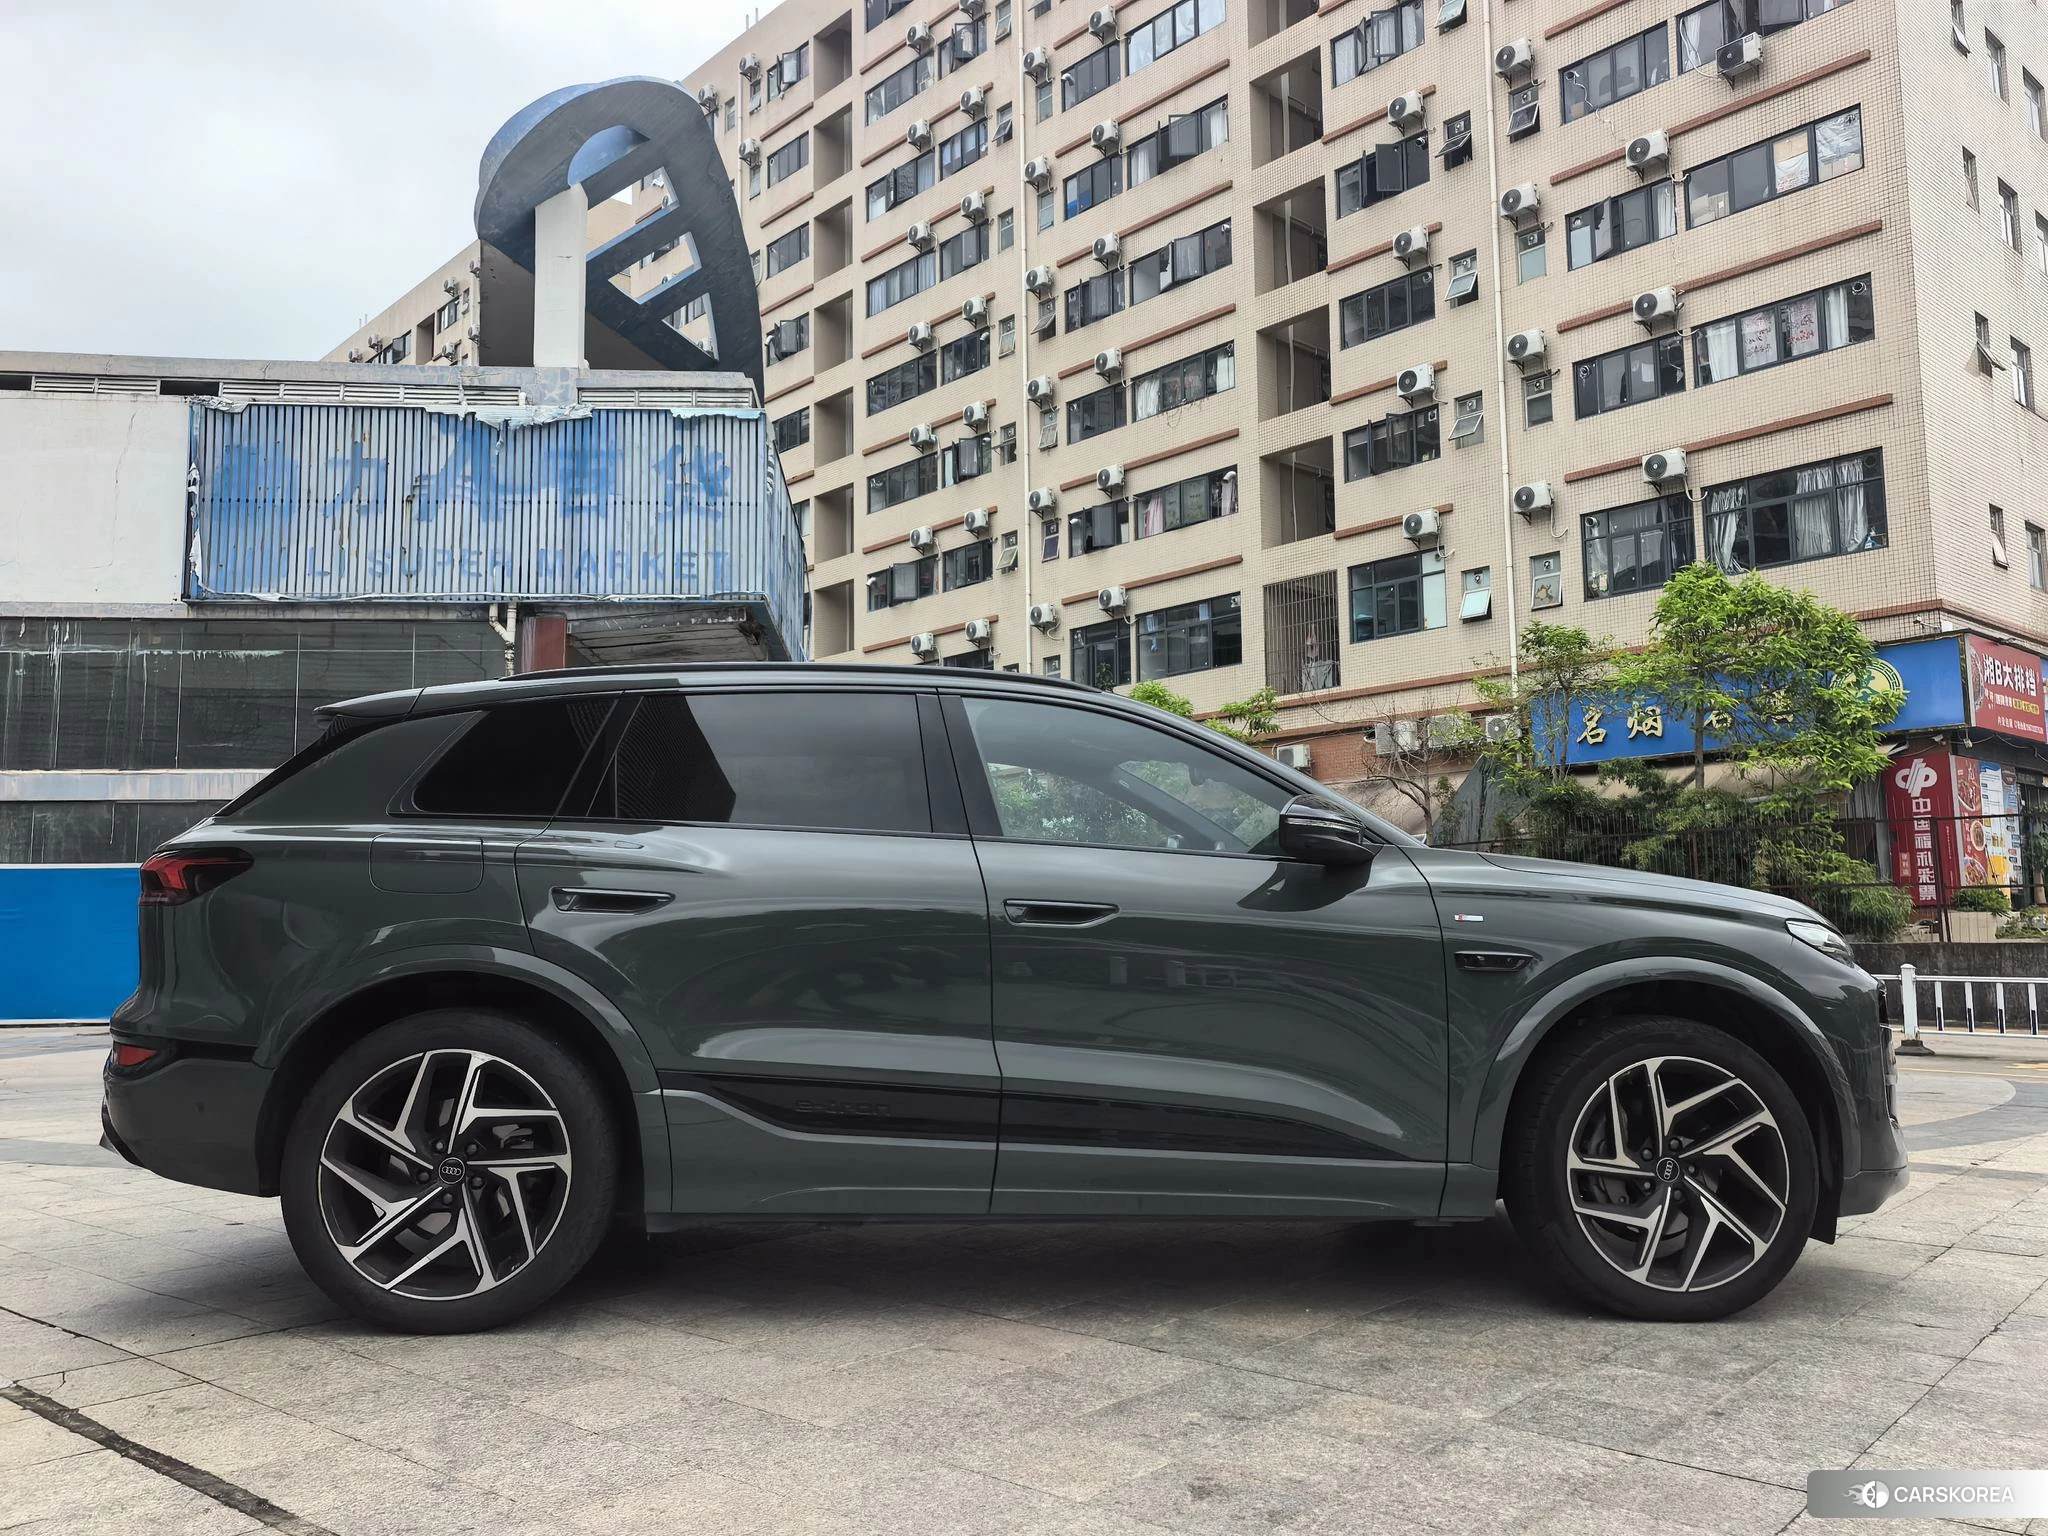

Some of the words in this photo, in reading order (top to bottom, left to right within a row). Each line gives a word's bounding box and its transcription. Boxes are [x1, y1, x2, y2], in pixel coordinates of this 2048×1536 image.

[1911, 798, 1937, 901] 中国福利彩票
